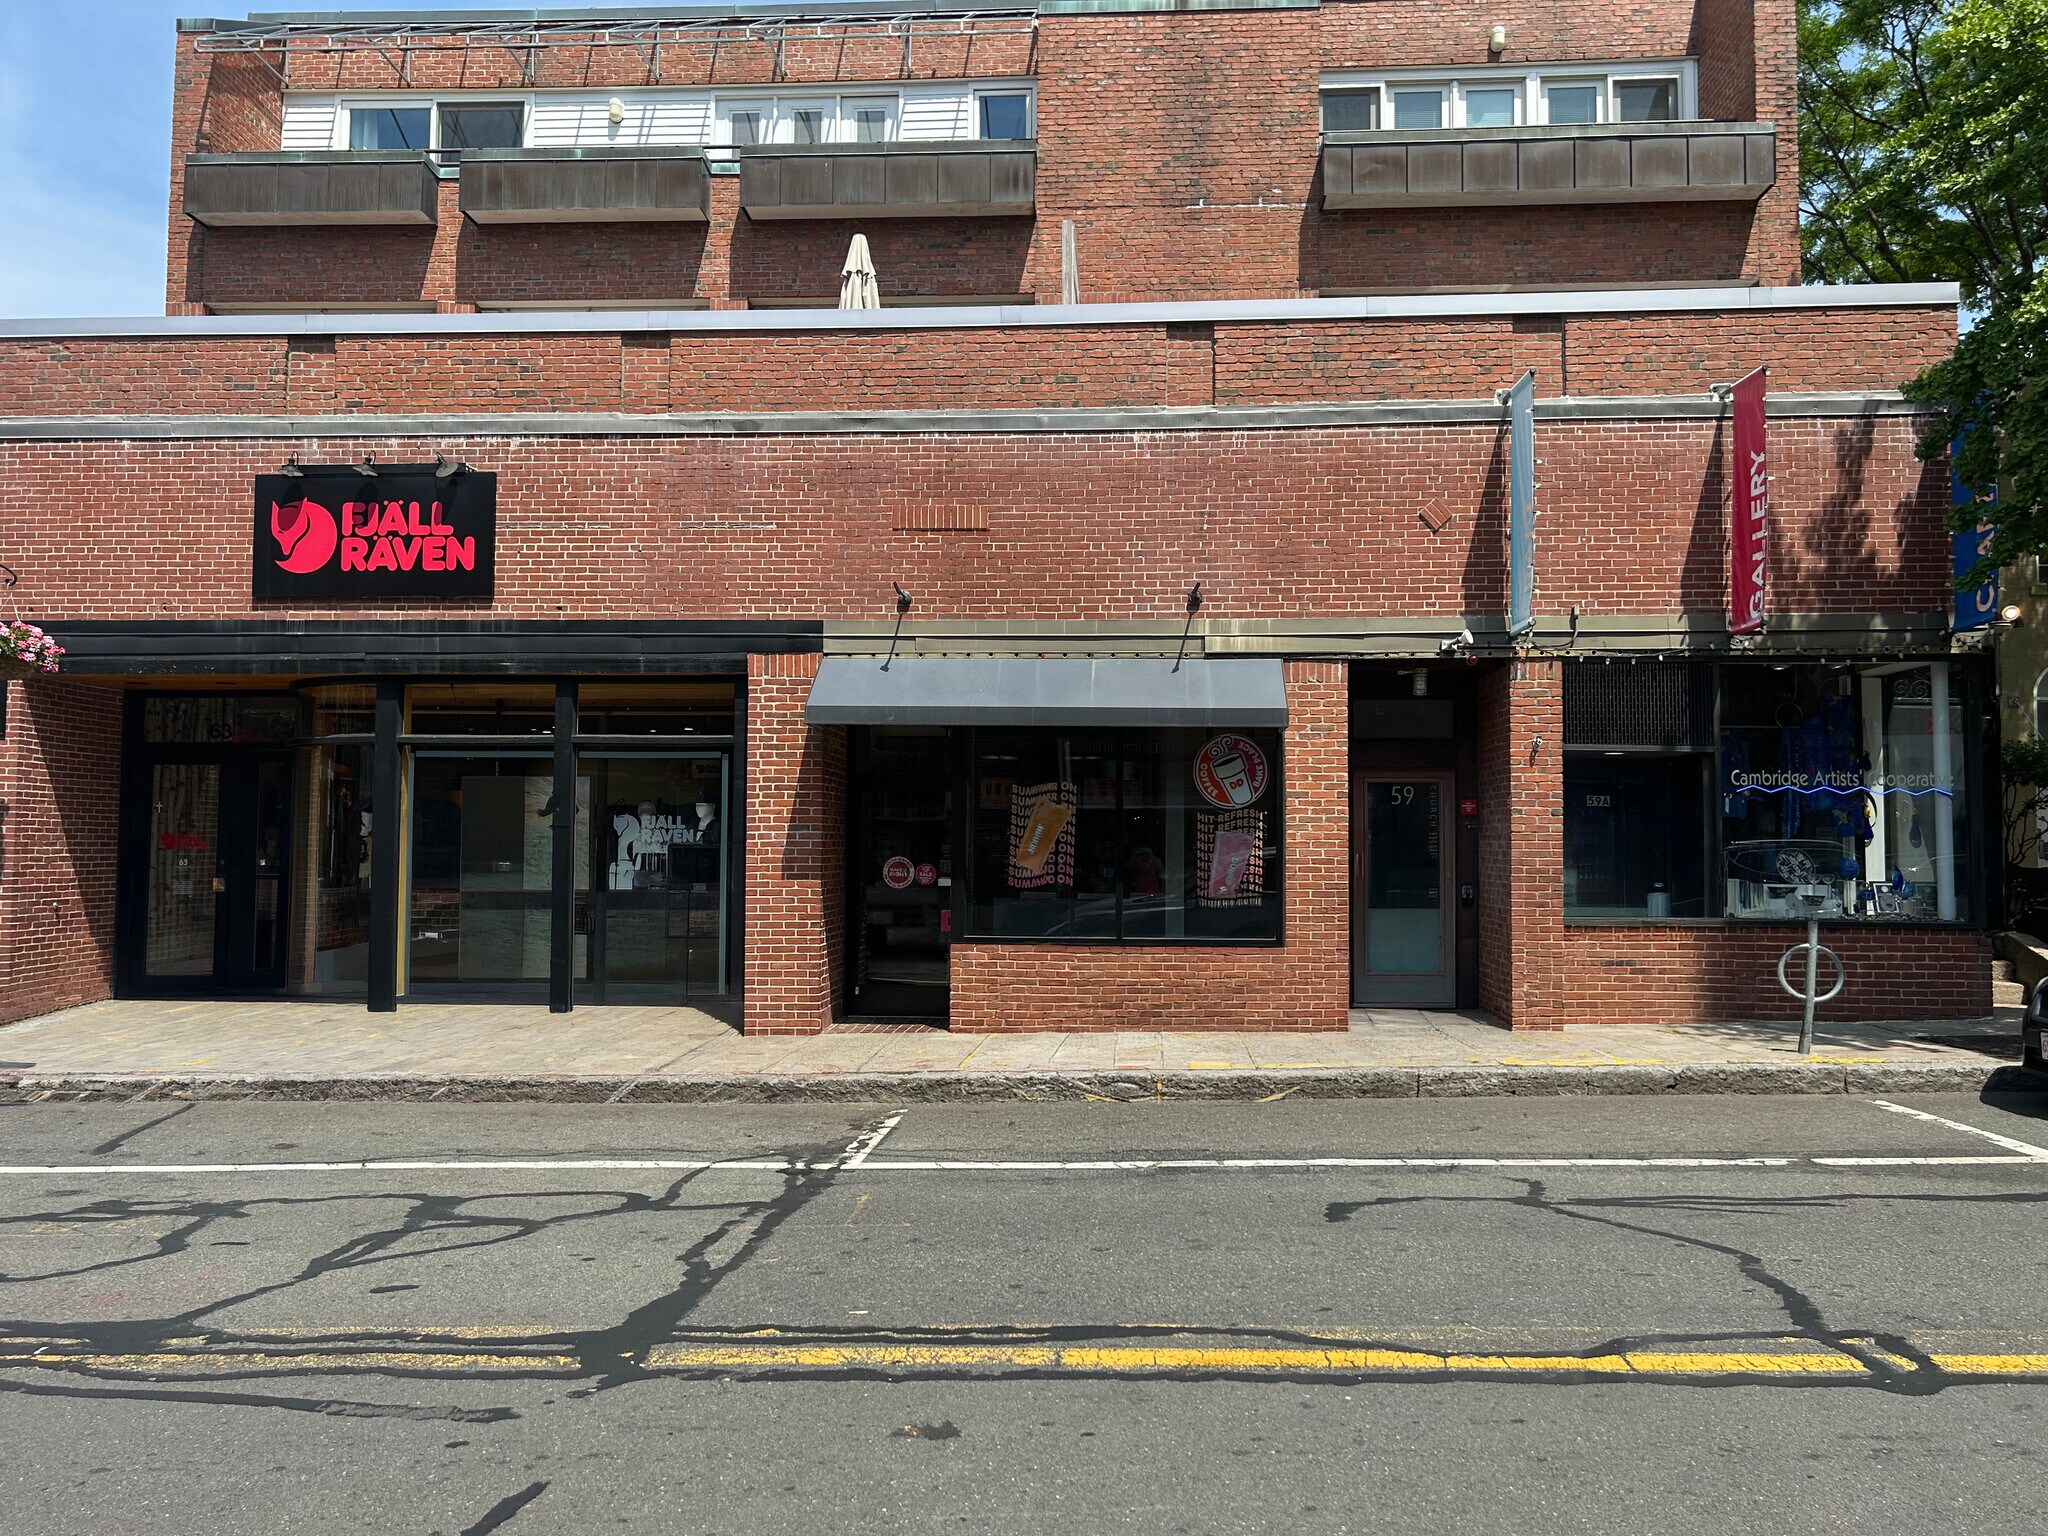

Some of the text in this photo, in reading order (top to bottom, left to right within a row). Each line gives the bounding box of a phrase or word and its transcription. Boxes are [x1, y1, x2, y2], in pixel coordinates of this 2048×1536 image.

[341, 500, 454, 537] FJÄLL
[1750, 451, 1766, 620] GALLERY
[341, 535, 475, 571] RÄVEN
[210, 723, 232, 738] 63
[1238, 742, 1263, 788] BAKE PLACE
[1200, 764, 1218, 797] COFFEE
[1229, 778, 1244, 790] DD
[1731, 769, 1954, 789] Cambridge Artists' Cooperatve
[1060, 781, 1076, 794] ON
[1060, 791, 1076, 804] ON
[1391, 786, 1414, 805] 59
[1588, 796, 1609, 805] 59A
[1429, 785, 1437, 827] CHURCH
[640, 814, 686, 829] FJÄLL
[1196, 808, 1263, 824] HIT REFRESH
[1196, 818, 1263, 833] HIT REFRESH
[640, 828, 694, 843] RÄVEN
[1058, 832, 1075, 846] ON
[1196, 830, 1215, 843] HIT
[1058, 842, 1075, 856] ON
[1196, 839, 1214, 853] HIT
[178, 858, 188, 866] 63
[1057, 853, 1074, 866] ON
[1057, 864, 1074, 877] ON
[1057, 875, 1073, 888] ON
